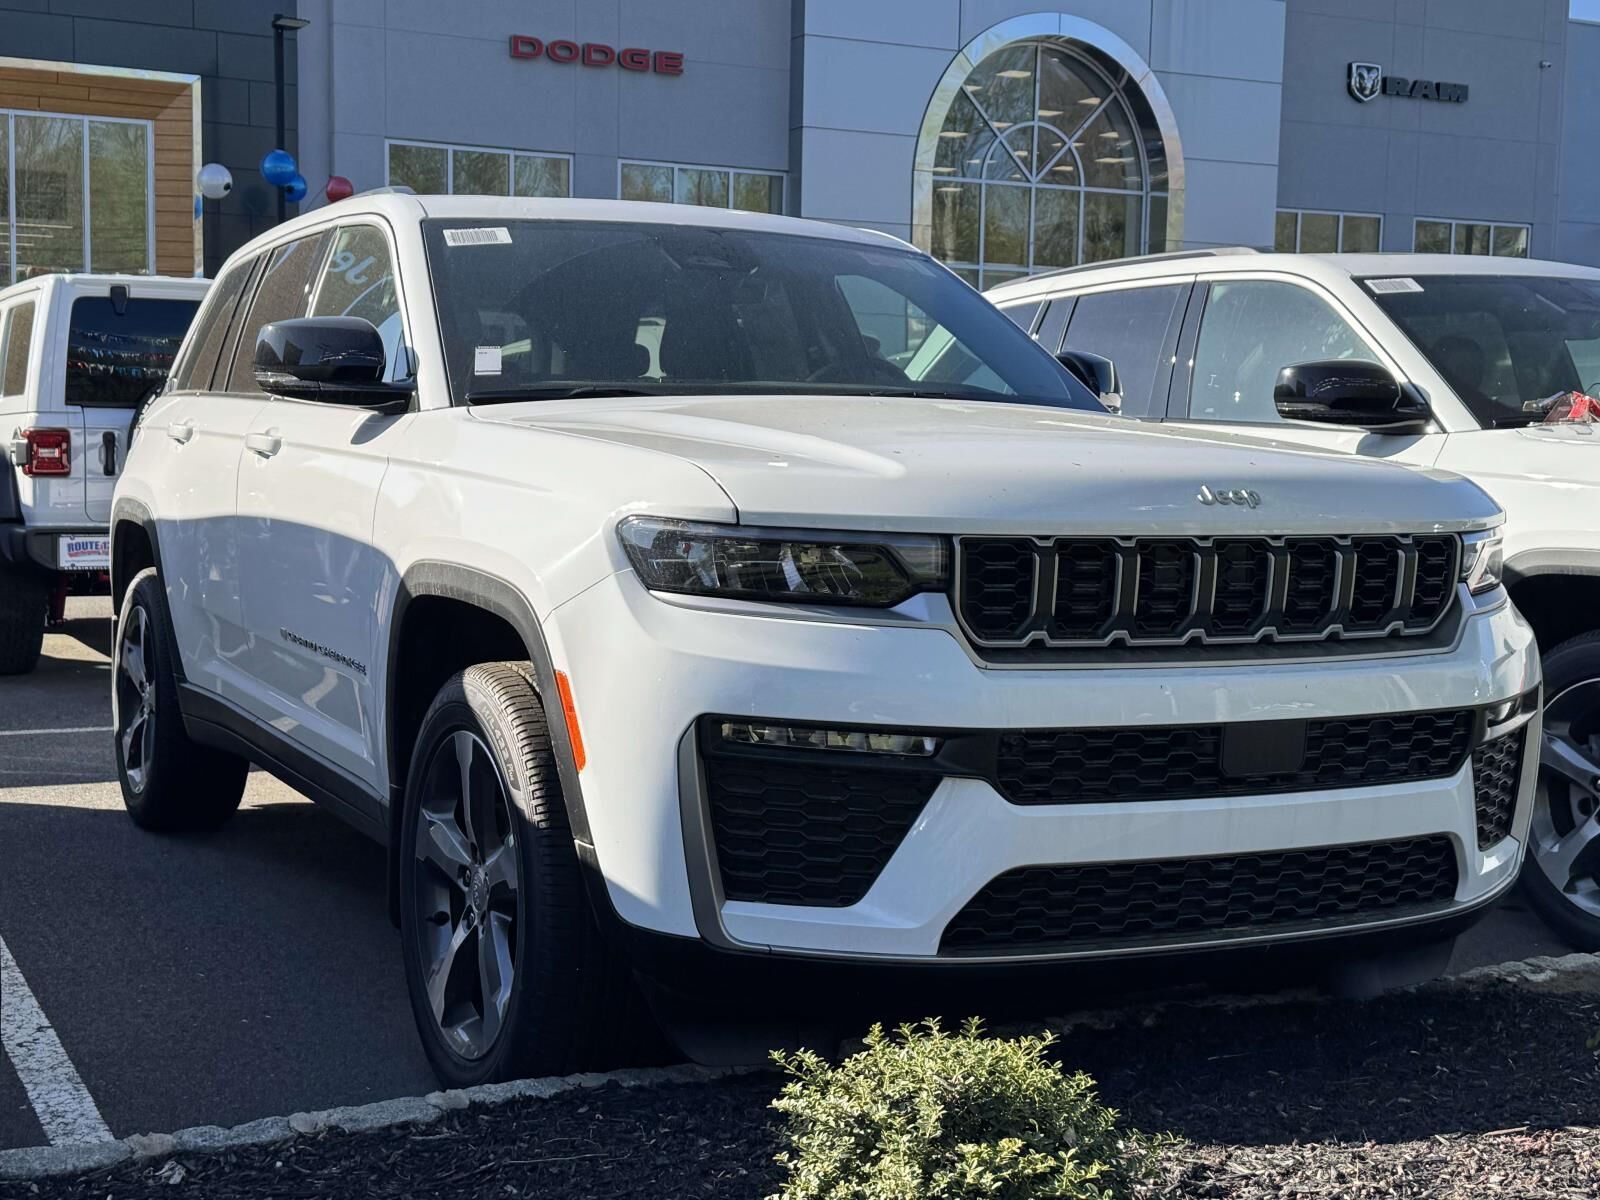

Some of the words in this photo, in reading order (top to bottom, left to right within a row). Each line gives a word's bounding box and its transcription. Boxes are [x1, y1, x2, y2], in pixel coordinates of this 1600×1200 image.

[510, 35, 684, 75] DODGE
[1381, 76, 1469, 103] RAM
[1197, 484, 1262, 510] Jeep
[67, 541, 100, 552] ROUTE
